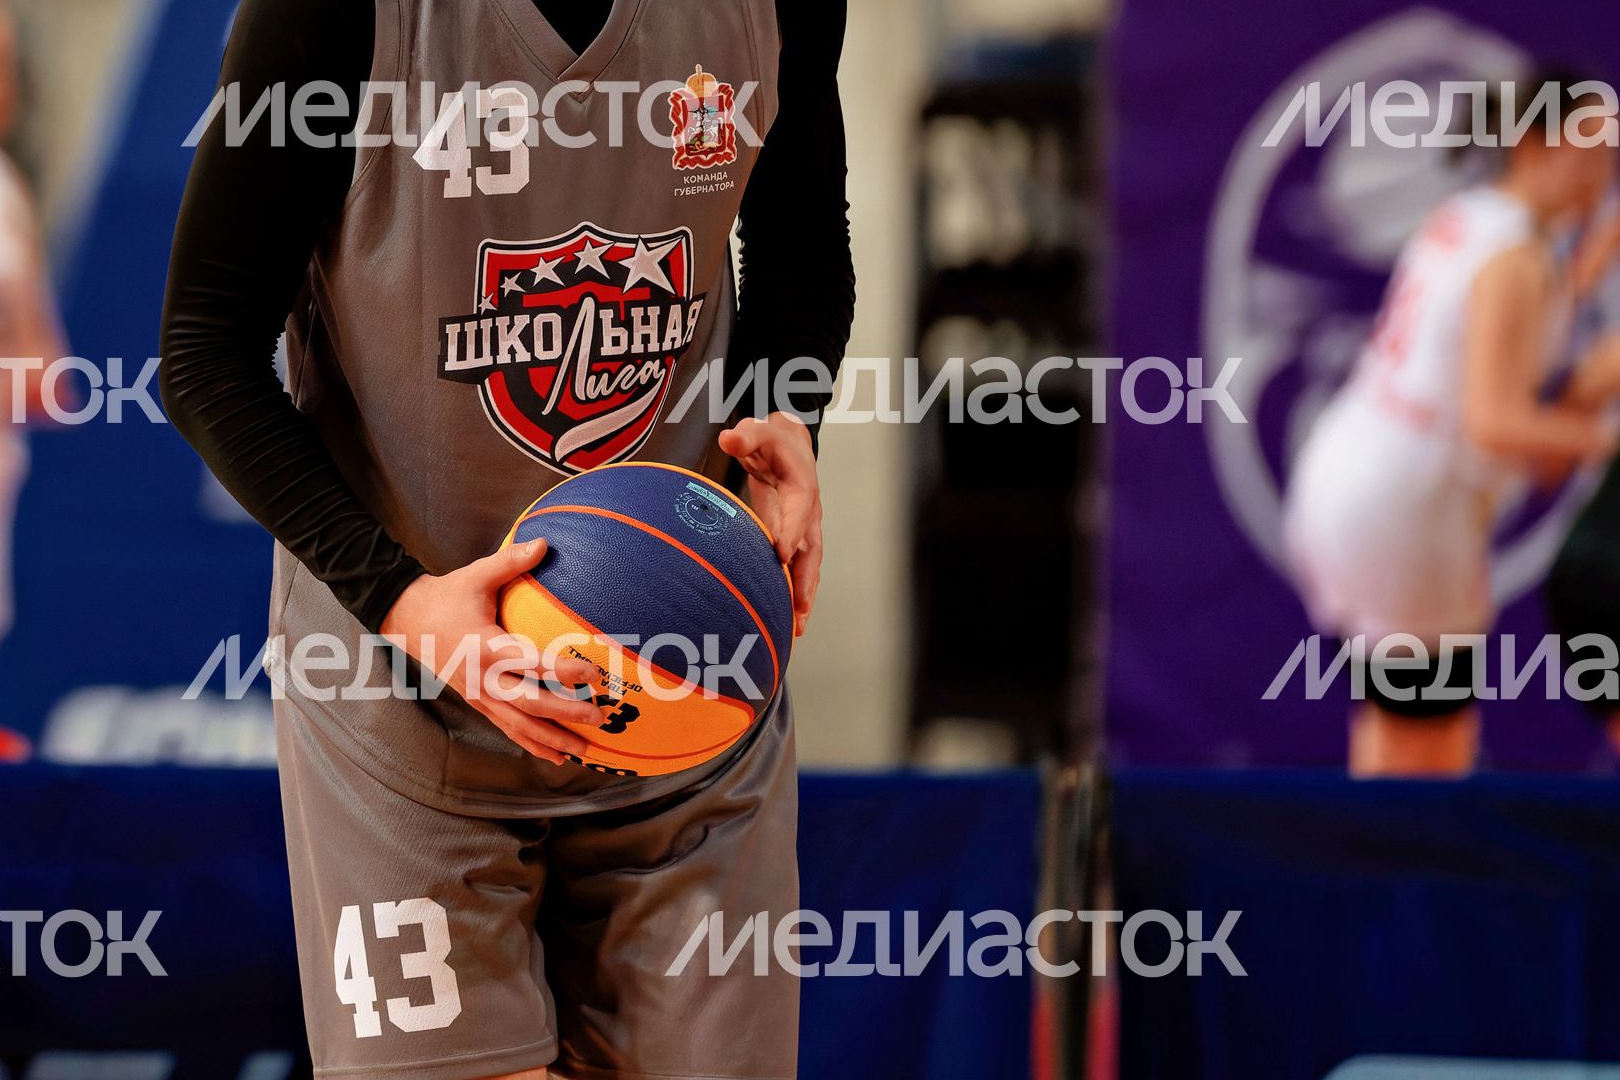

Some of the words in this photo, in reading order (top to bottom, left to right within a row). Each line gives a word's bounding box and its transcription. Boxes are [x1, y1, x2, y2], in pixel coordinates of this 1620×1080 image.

[412, 87, 530, 198] 43
[683, 171, 728, 185] КОМАНДА
[674, 180, 735, 197] ГУБЕРНАТОРА
[445, 297, 704, 372] ШКОЛЬНАЯ
[541, 296, 666, 416] Лига
[600, 678, 628, 697] FIBA
[333, 897, 463, 1039] 43
